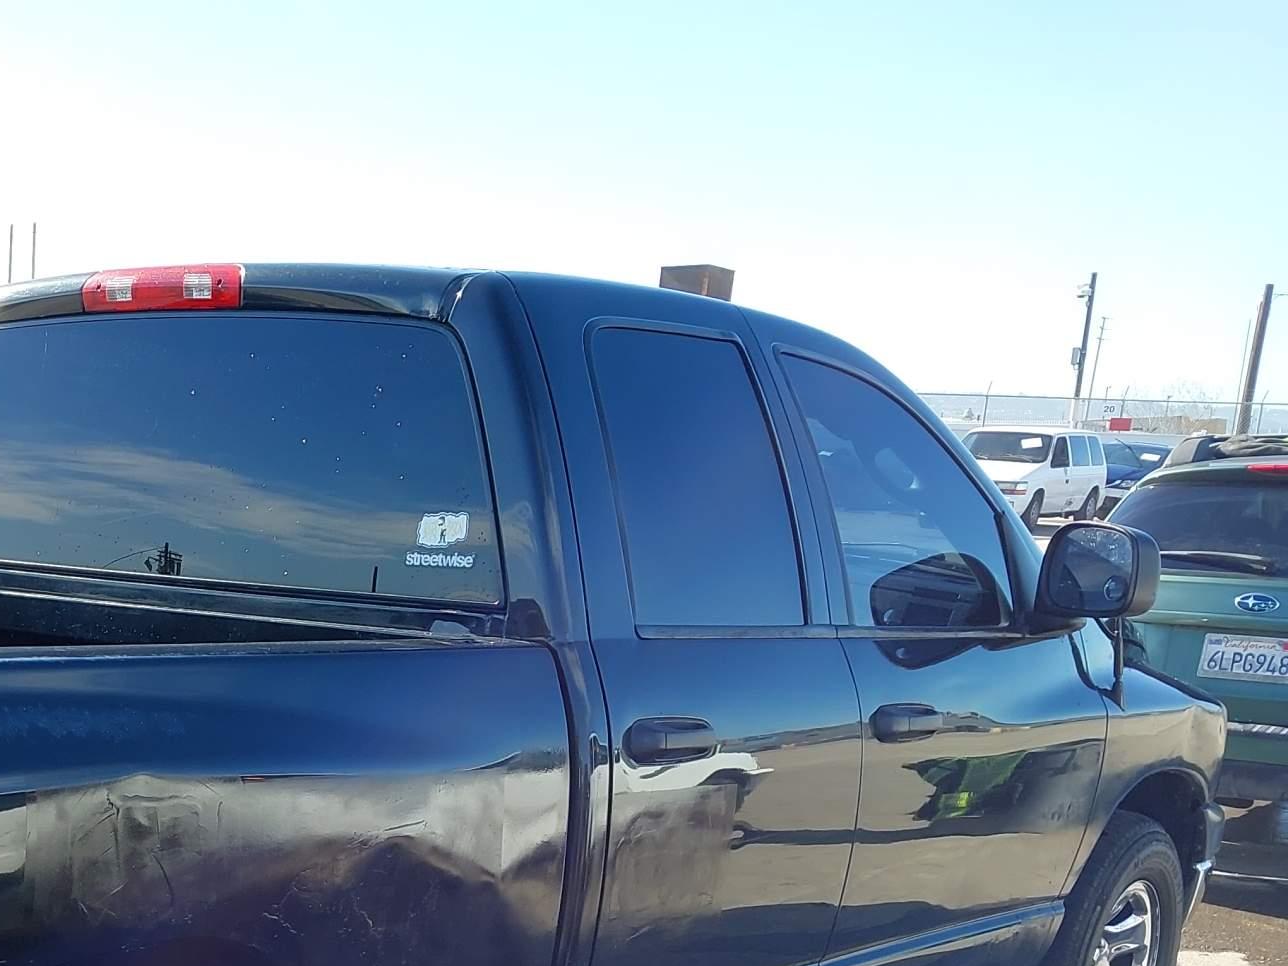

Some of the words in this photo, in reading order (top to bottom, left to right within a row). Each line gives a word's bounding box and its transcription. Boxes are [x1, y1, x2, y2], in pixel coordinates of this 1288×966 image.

[1103, 405, 1116, 413] 20
[405, 552, 474, 568] streetwise
[1223, 635, 1277, 652] California
[1206, 650, 1288, 675] 6LPG948
